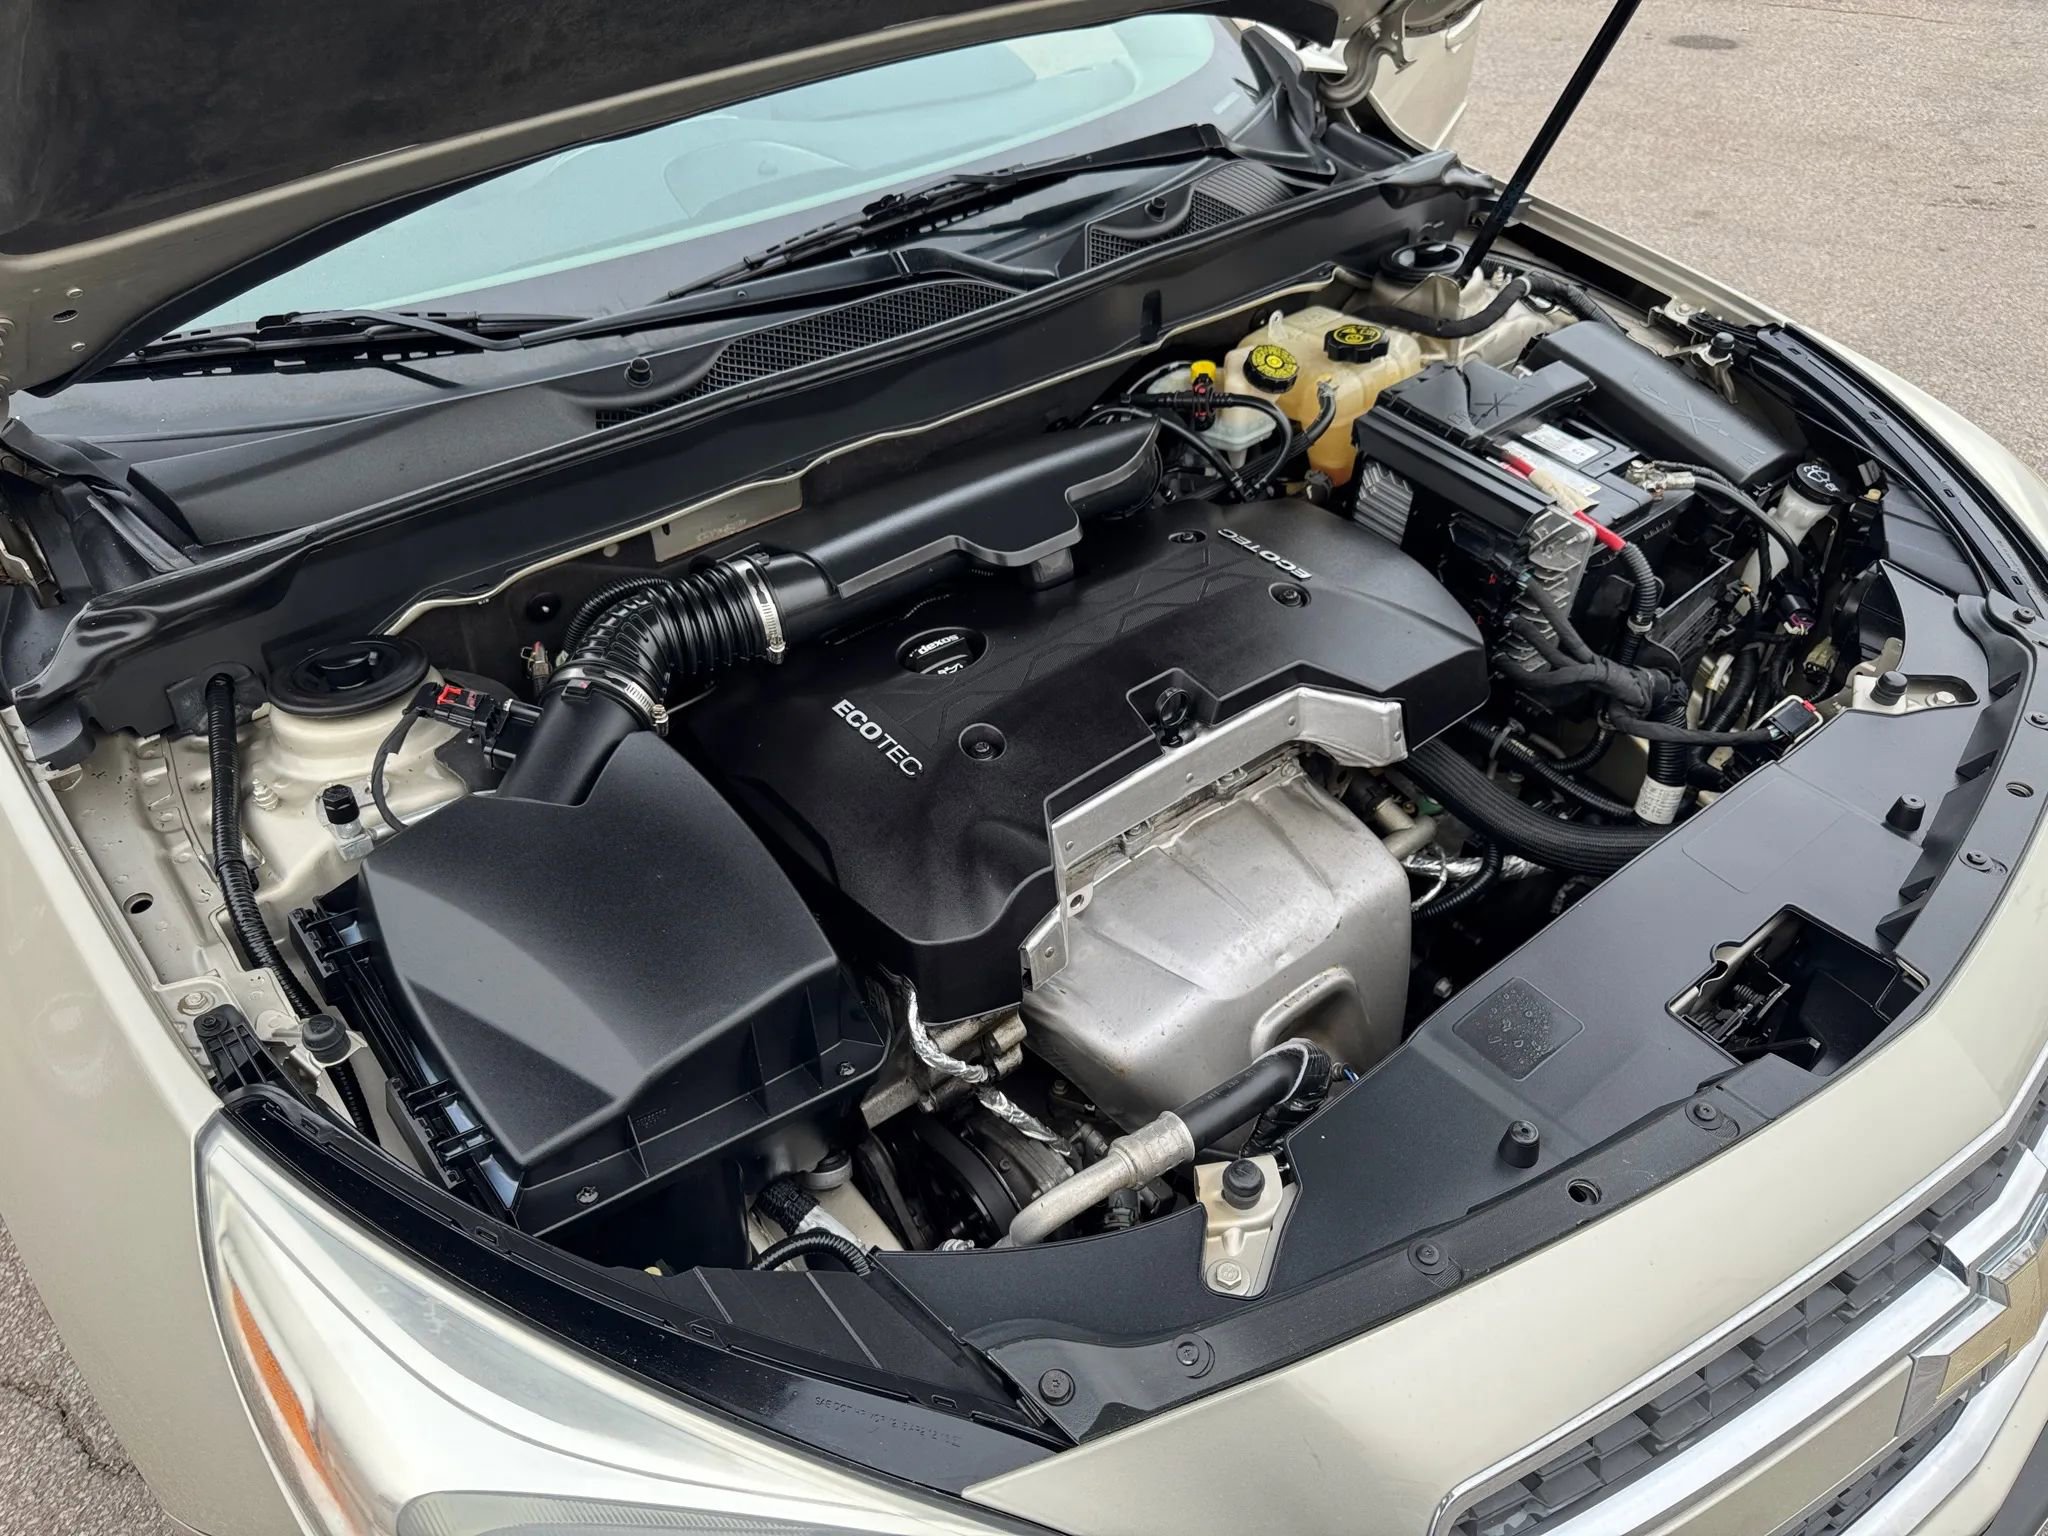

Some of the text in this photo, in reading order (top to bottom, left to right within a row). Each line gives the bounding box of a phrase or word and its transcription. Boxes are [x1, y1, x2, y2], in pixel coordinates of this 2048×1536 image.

[1217, 528, 1312, 579] ECOTEC
[917, 634, 959, 655] dexos
[831, 698, 923, 777] ECOTEC
